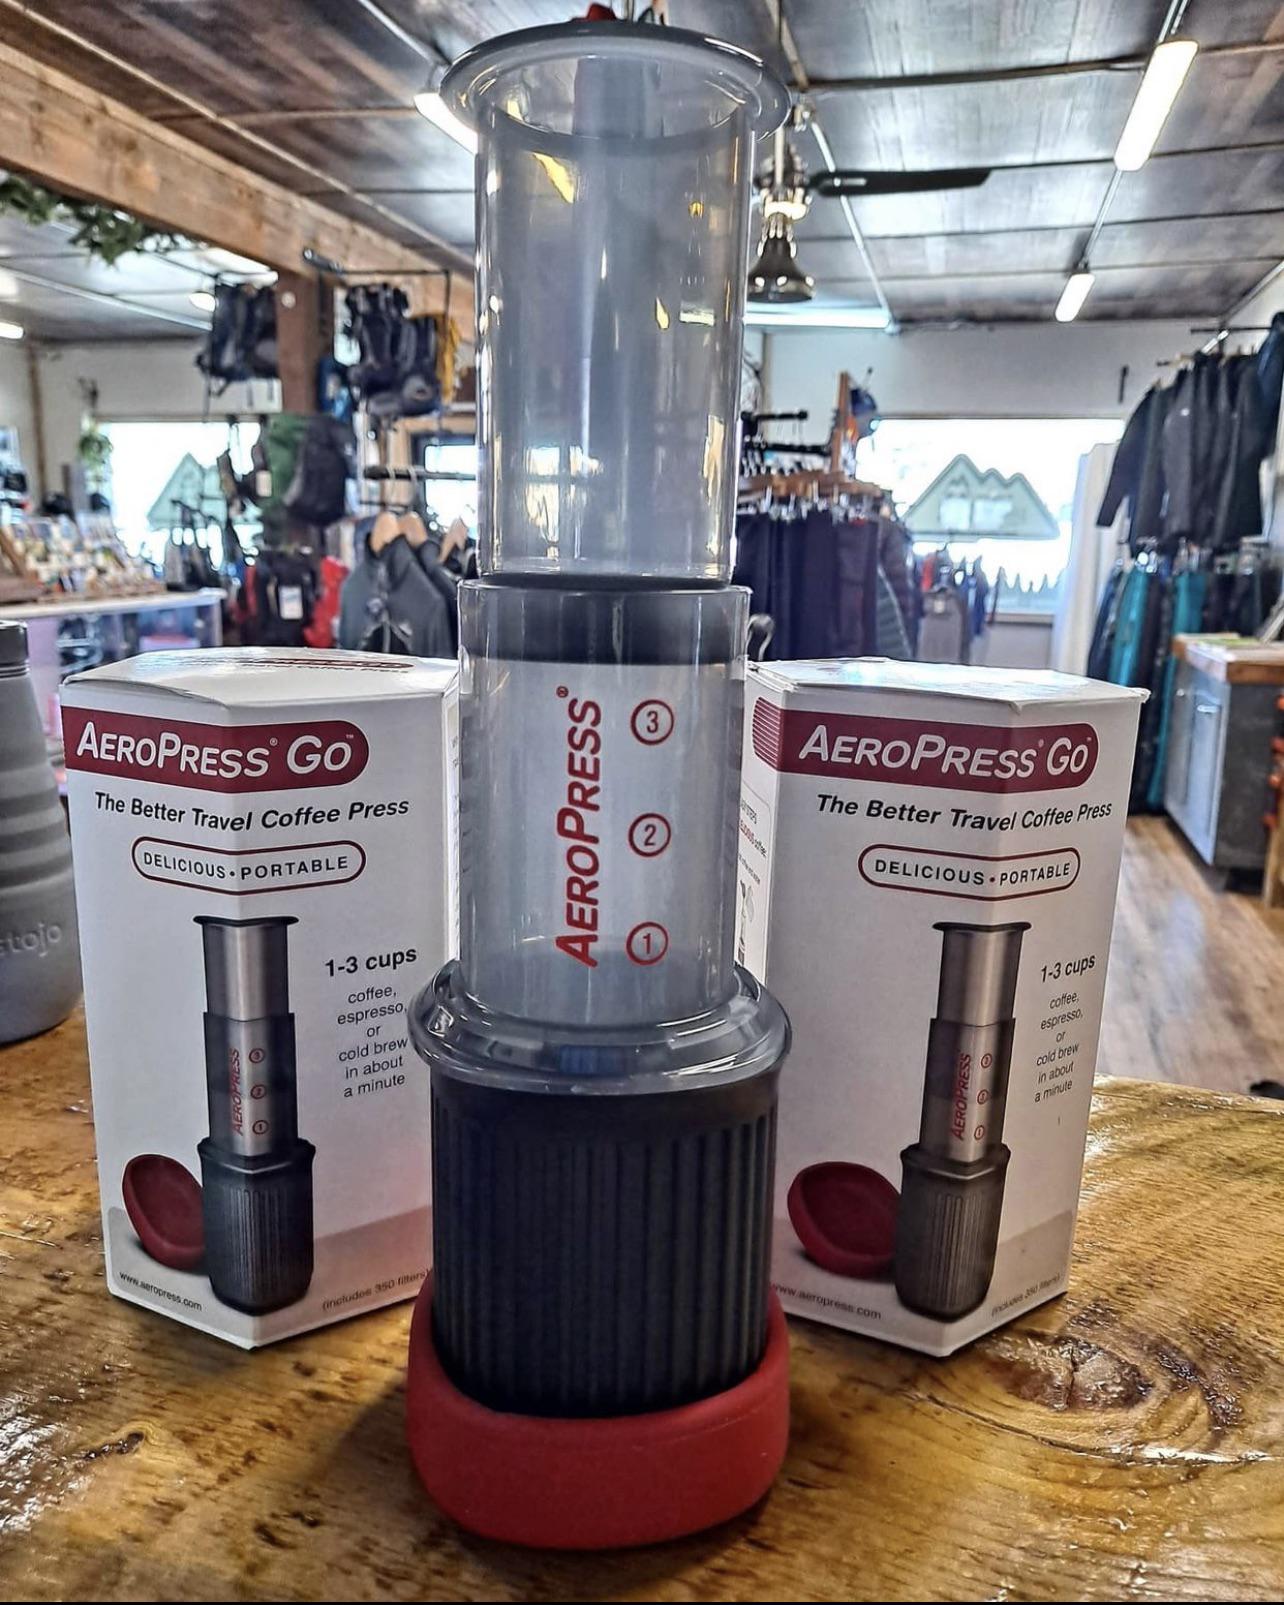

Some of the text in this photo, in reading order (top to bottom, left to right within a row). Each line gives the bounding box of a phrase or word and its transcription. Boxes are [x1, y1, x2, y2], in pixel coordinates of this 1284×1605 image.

[95, 792, 410, 832] The Better Travel Coffee Press
[817, 794, 1113, 832] The Better Travel Coffee Press
[143, 851, 349, 881] DELICIOUS PORTABLE
[874, 858, 1071, 887] DELICIOUS PORTABLE
[325, 948, 417, 977] 1-3 cups
[1040, 954, 1096, 983] 1-3 cups
[348, 985, 397, 1004] coffee,
[1049, 991, 1079, 1010] coffee,
[337, 1002, 407, 1025] espresso,
[1040, 1008, 1083, 1031] espresso,
[366, 1026, 381, 1038] or
[1055, 1030, 1066, 1043] or
[338, 1038, 409, 1062] cold brew
[1036, 1043, 1079, 1066] cold brew
[345, 1055, 404, 1080] in about
[1038, 1061, 1075, 1084] in about
[343, 1074, 406, 1098] a minute
[1034, 1079, 1073, 1102] a minute
[119, 1270, 203, 1312] www.aeropress.com
